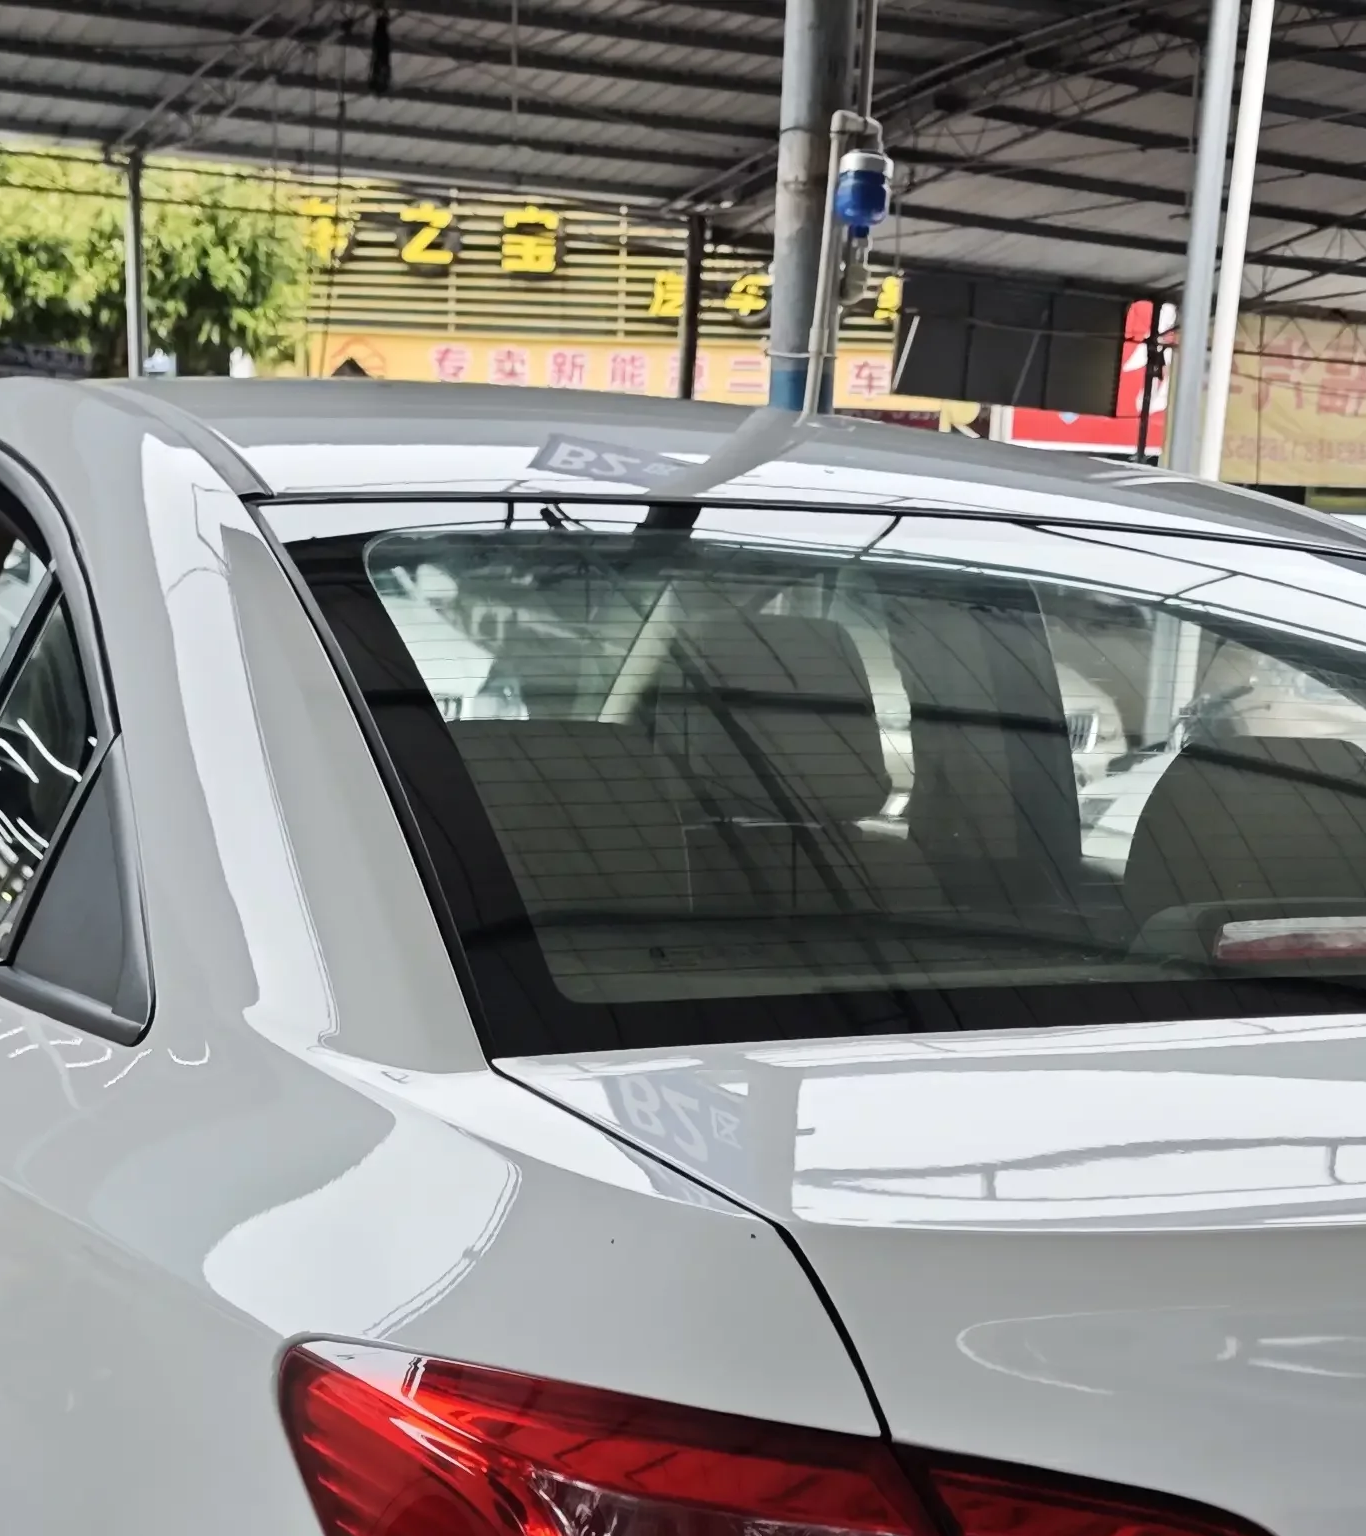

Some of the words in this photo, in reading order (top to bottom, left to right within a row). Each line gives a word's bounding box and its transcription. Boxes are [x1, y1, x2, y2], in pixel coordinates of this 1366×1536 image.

[434, 345, 893, 397] 专卖新能源二车
